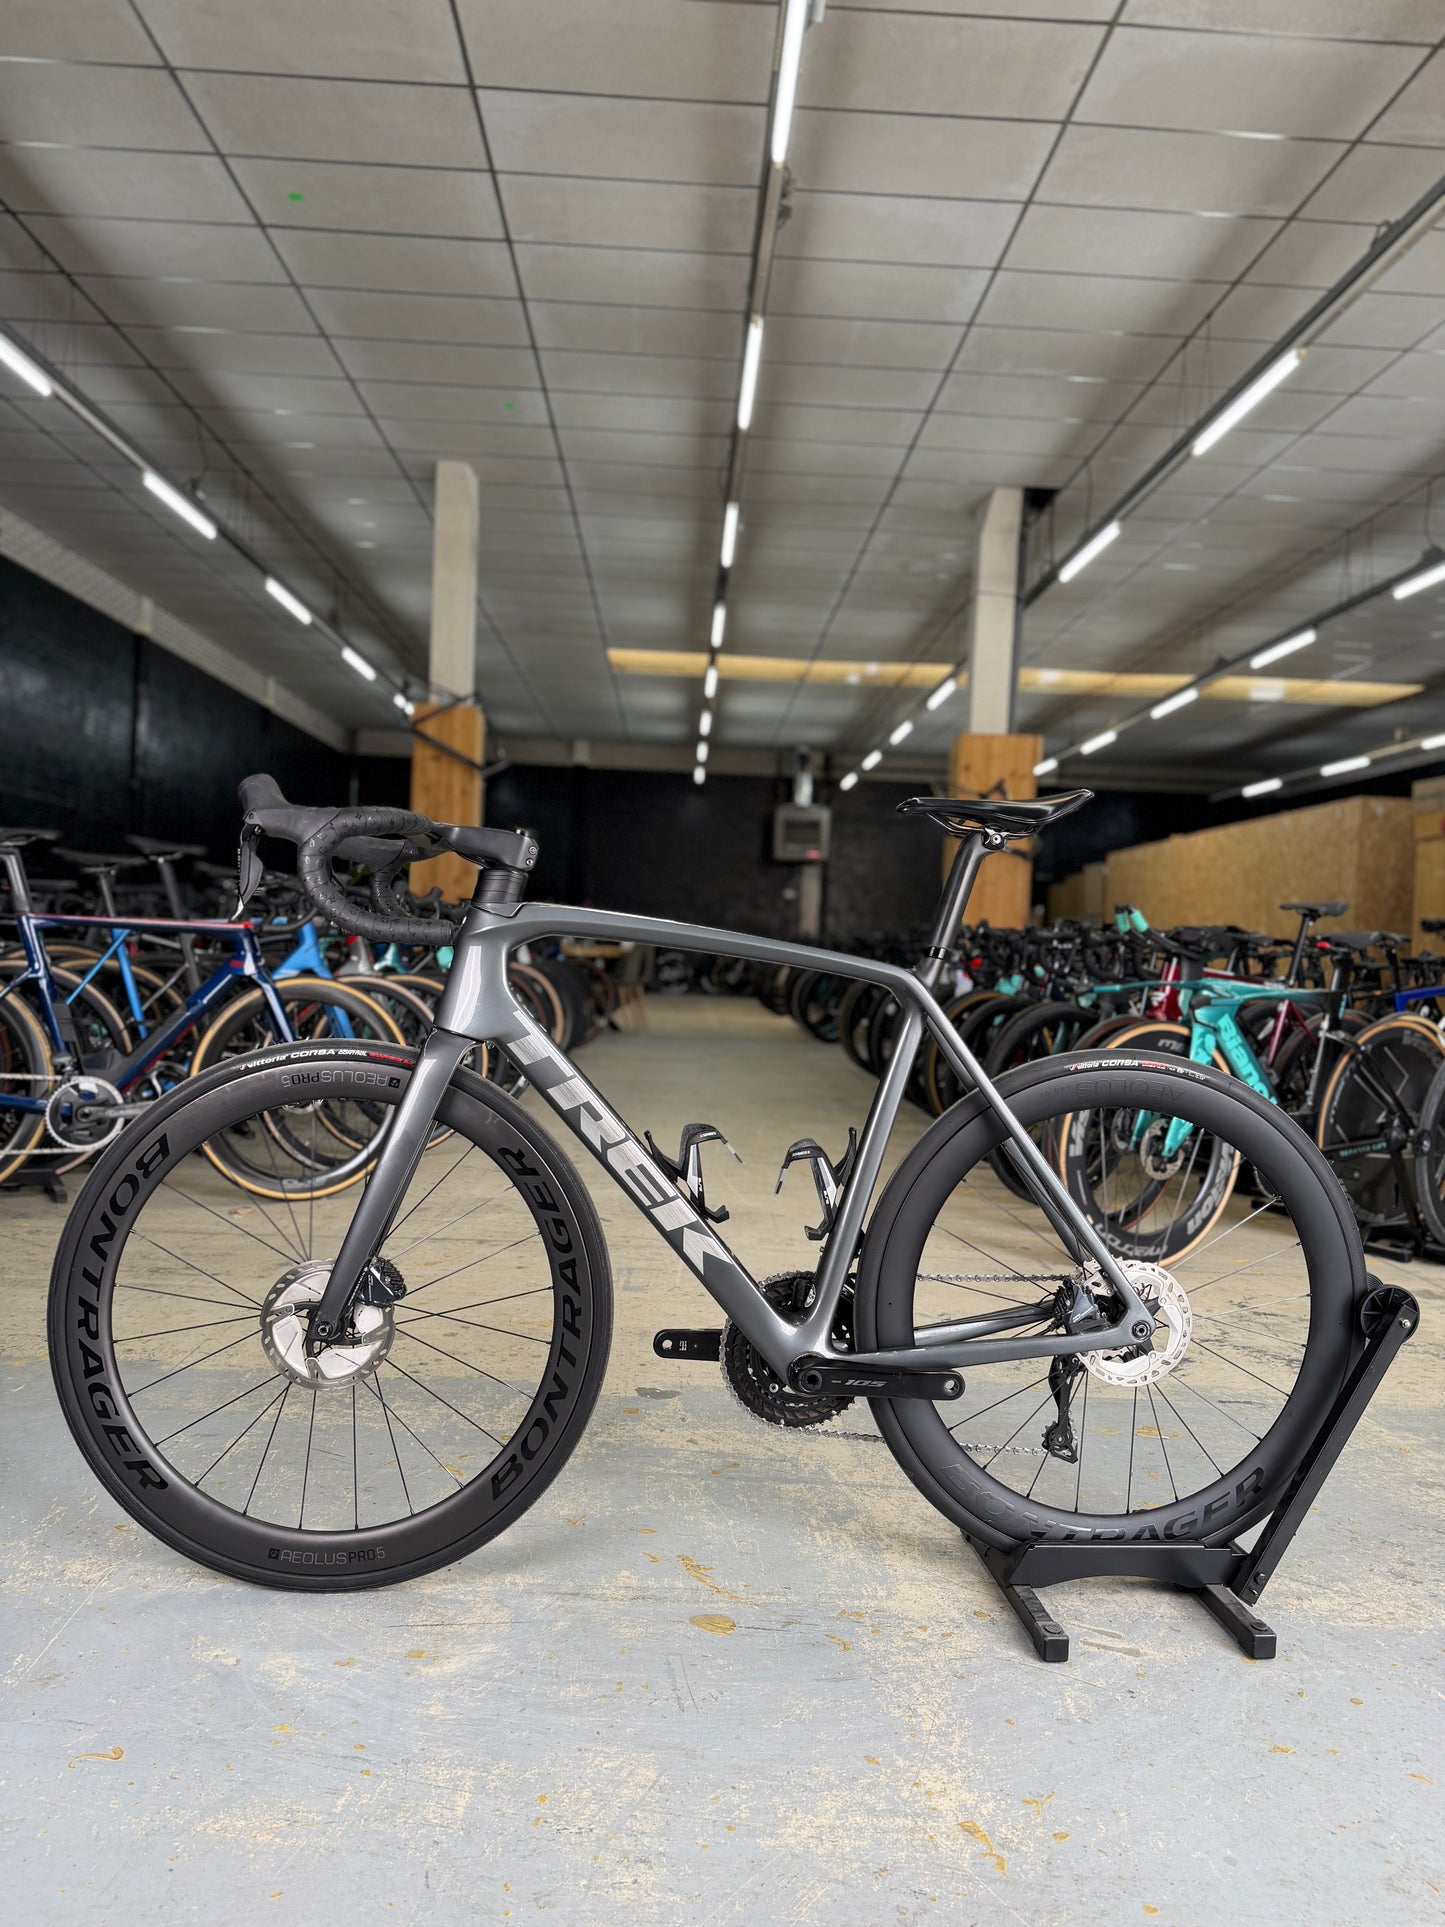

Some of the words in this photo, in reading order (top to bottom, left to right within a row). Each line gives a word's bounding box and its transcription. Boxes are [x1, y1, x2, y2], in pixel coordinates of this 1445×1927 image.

[290, 1048, 335, 1060] CORSA
[1101, 1059, 1139, 1068] CORSA
[507, 1010, 733, 1275] TREK
[77, 1132, 170, 1491] BONTRAGER
[491, 1147, 582, 1501] BONTRAGER
[844, 1378, 888, 1389] 105
